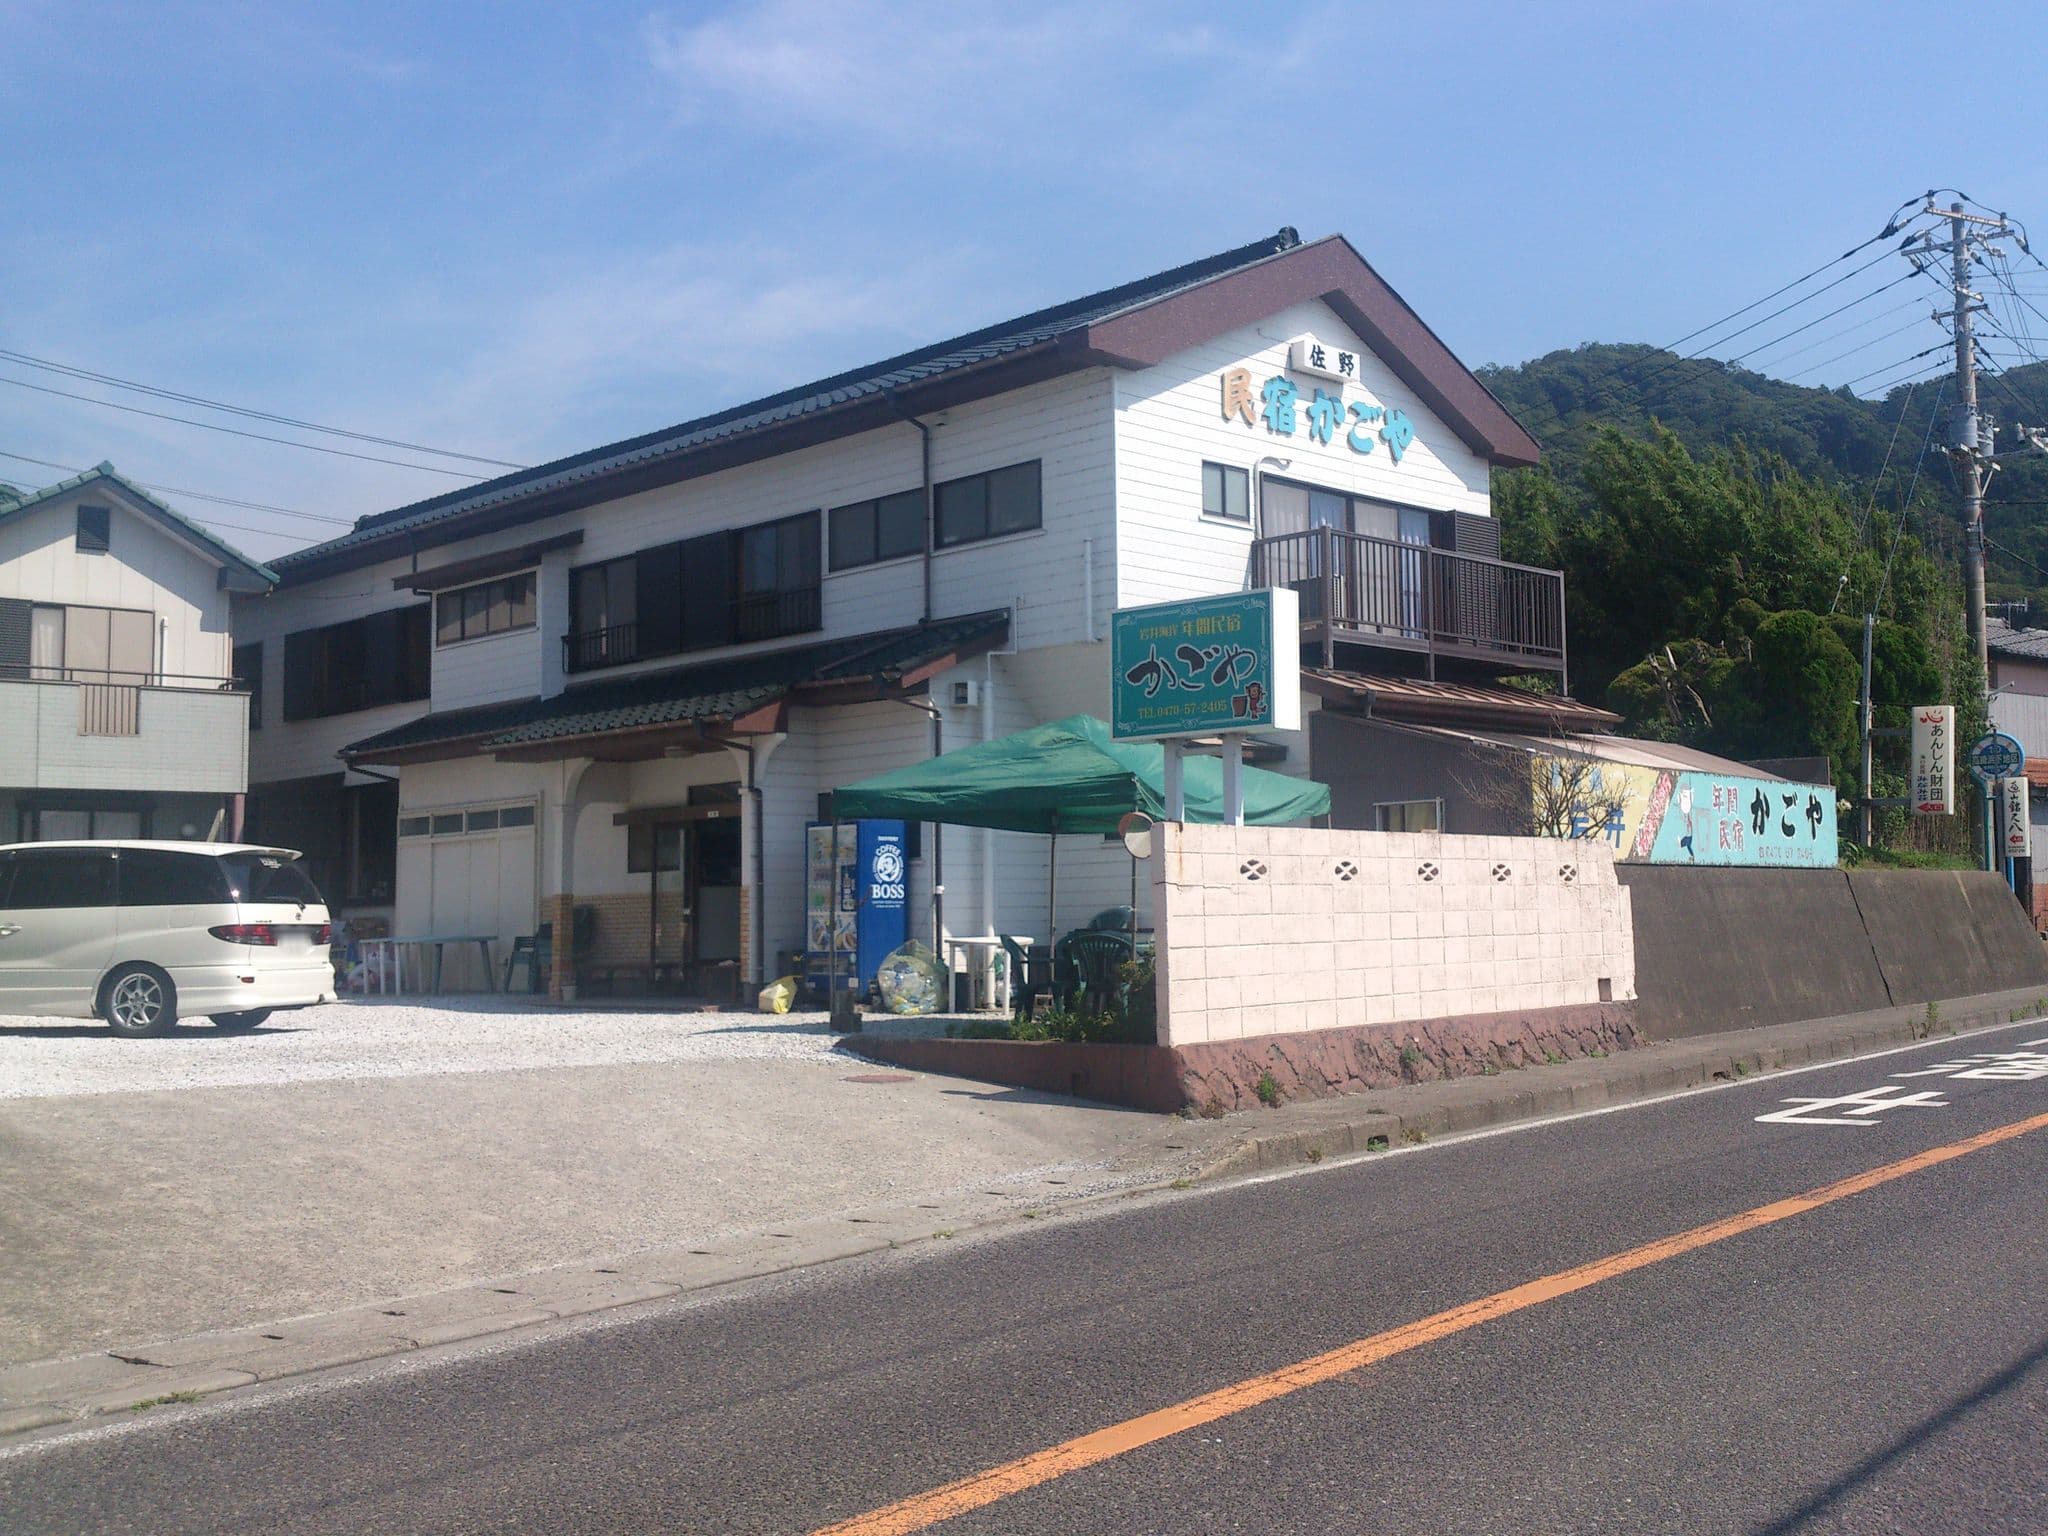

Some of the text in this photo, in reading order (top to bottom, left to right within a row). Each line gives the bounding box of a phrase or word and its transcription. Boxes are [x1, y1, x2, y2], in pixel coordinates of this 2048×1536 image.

[1309, 344, 1355, 377] 佐野
[1222, 367, 1415, 465] 民宿かごや
[1125, 643, 1257, 699] かごや
[1930, 724, 1944, 801] あんしん財団
[1750, 786, 1823, 841] かごや
[875, 844, 901, 856] COFFEE
[871, 884, 905, 899] BOSS
